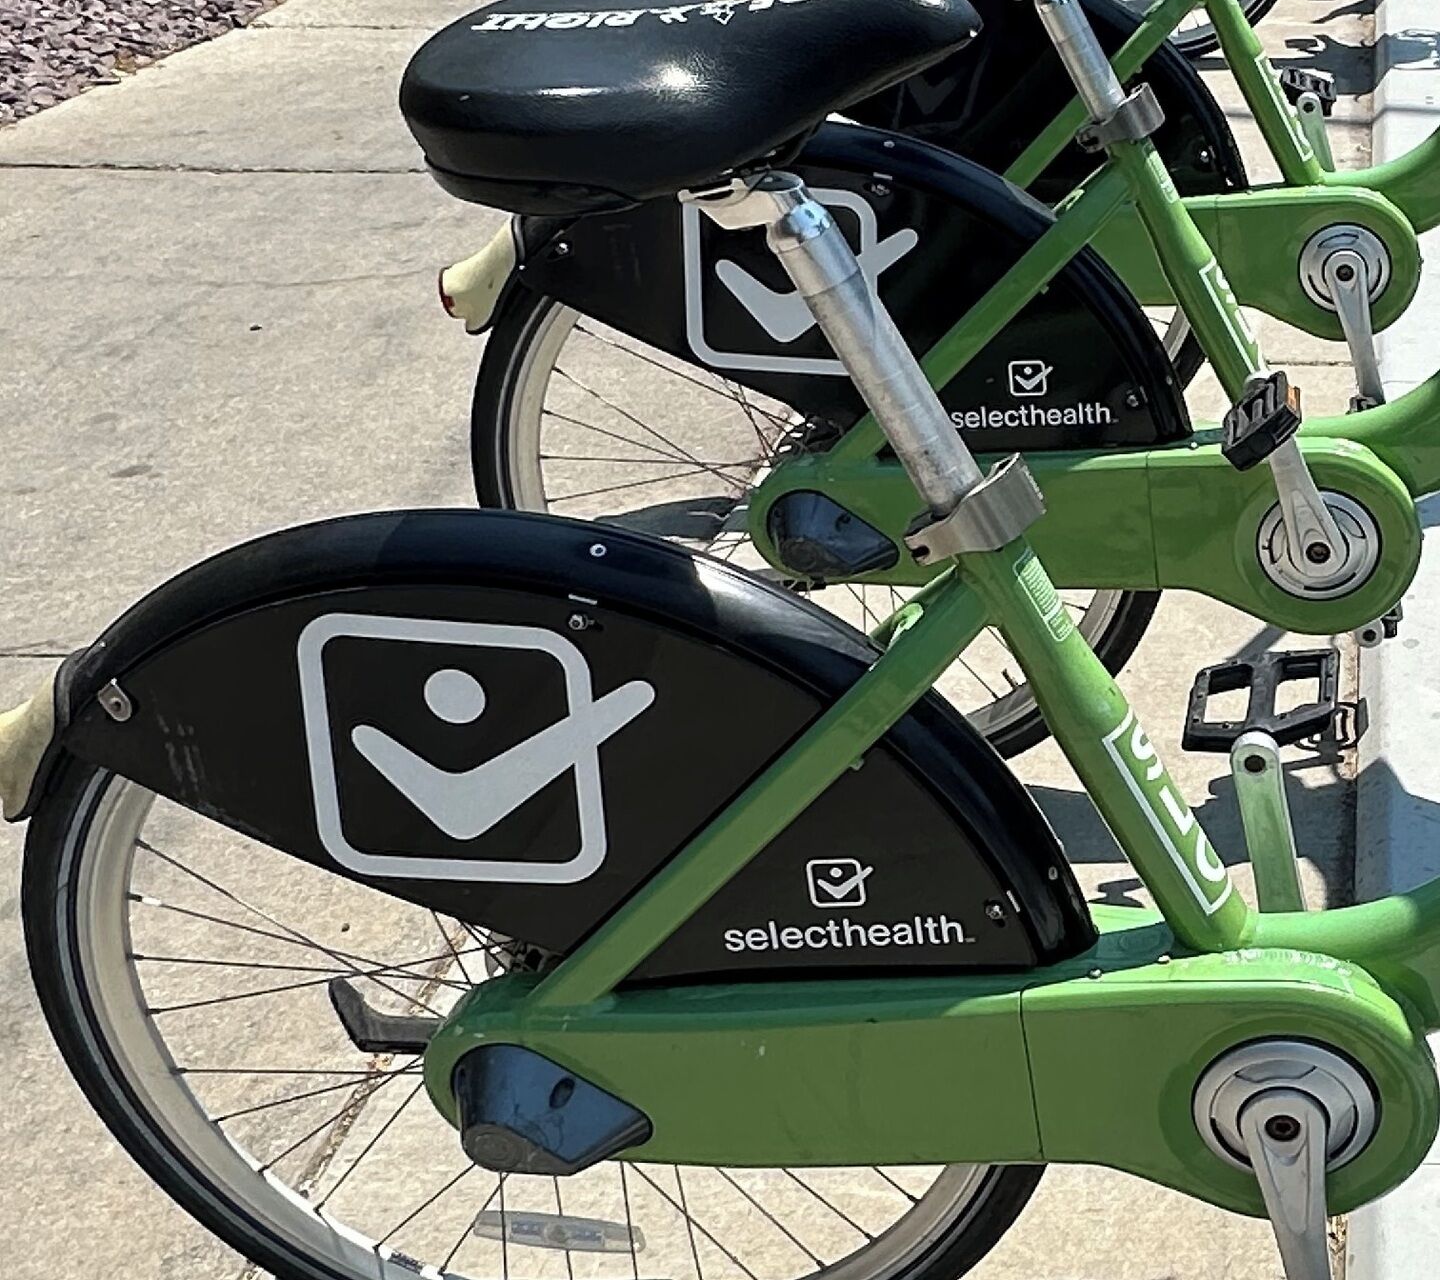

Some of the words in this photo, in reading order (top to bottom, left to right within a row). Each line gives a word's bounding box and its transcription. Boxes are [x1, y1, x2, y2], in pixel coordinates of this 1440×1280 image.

[471, 9, 647, 31] RIGHT
[951, 401, 1111, 429] selecthealth
[724, 914, 965, 952] selecthealth
